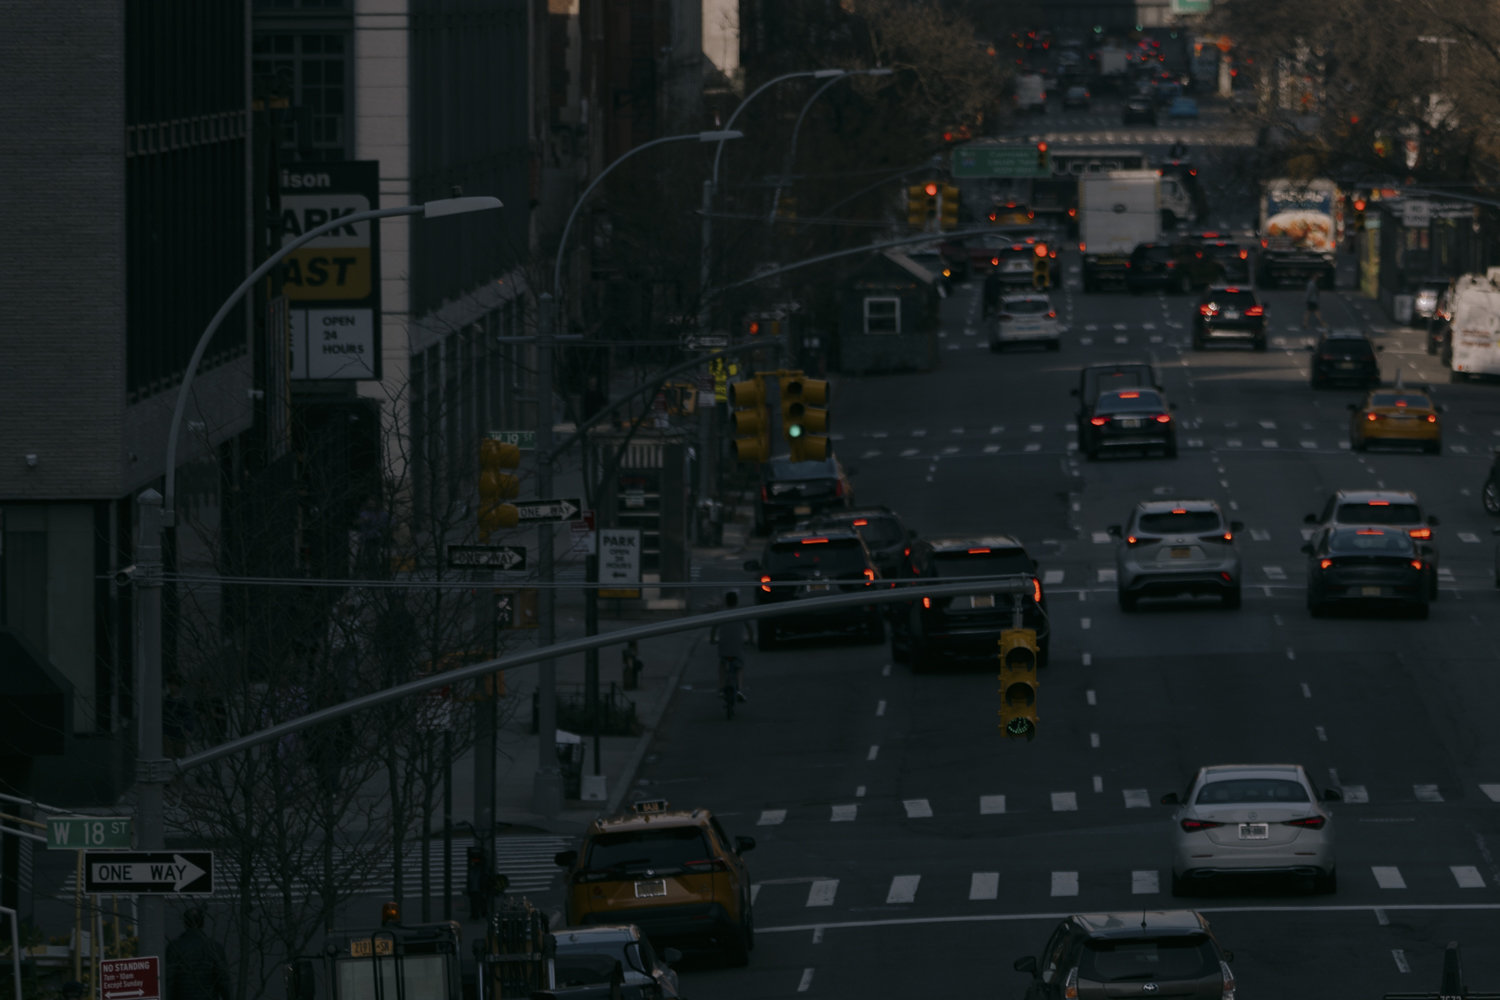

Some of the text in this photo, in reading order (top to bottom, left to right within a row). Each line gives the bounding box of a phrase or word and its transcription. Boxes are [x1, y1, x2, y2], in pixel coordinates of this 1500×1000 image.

[322, 316, 355, 326] OPEN
[323, 330, 337, 340] 24
[322, 344, 364, 354] HOURS
[506, 433, 519, 445] 19
[521, 505, 572, 517] ONE WAY
[603, 536, 635, 546] PARK
[53, 822, 127, 845] W 18 ST
[98, 865, 187, 881] ONE WAY
[103, 961, 150, 973] NO STANDING
[103, 974, 115, 982] 7am
[103, 980, 144, 990] Except Sunday
